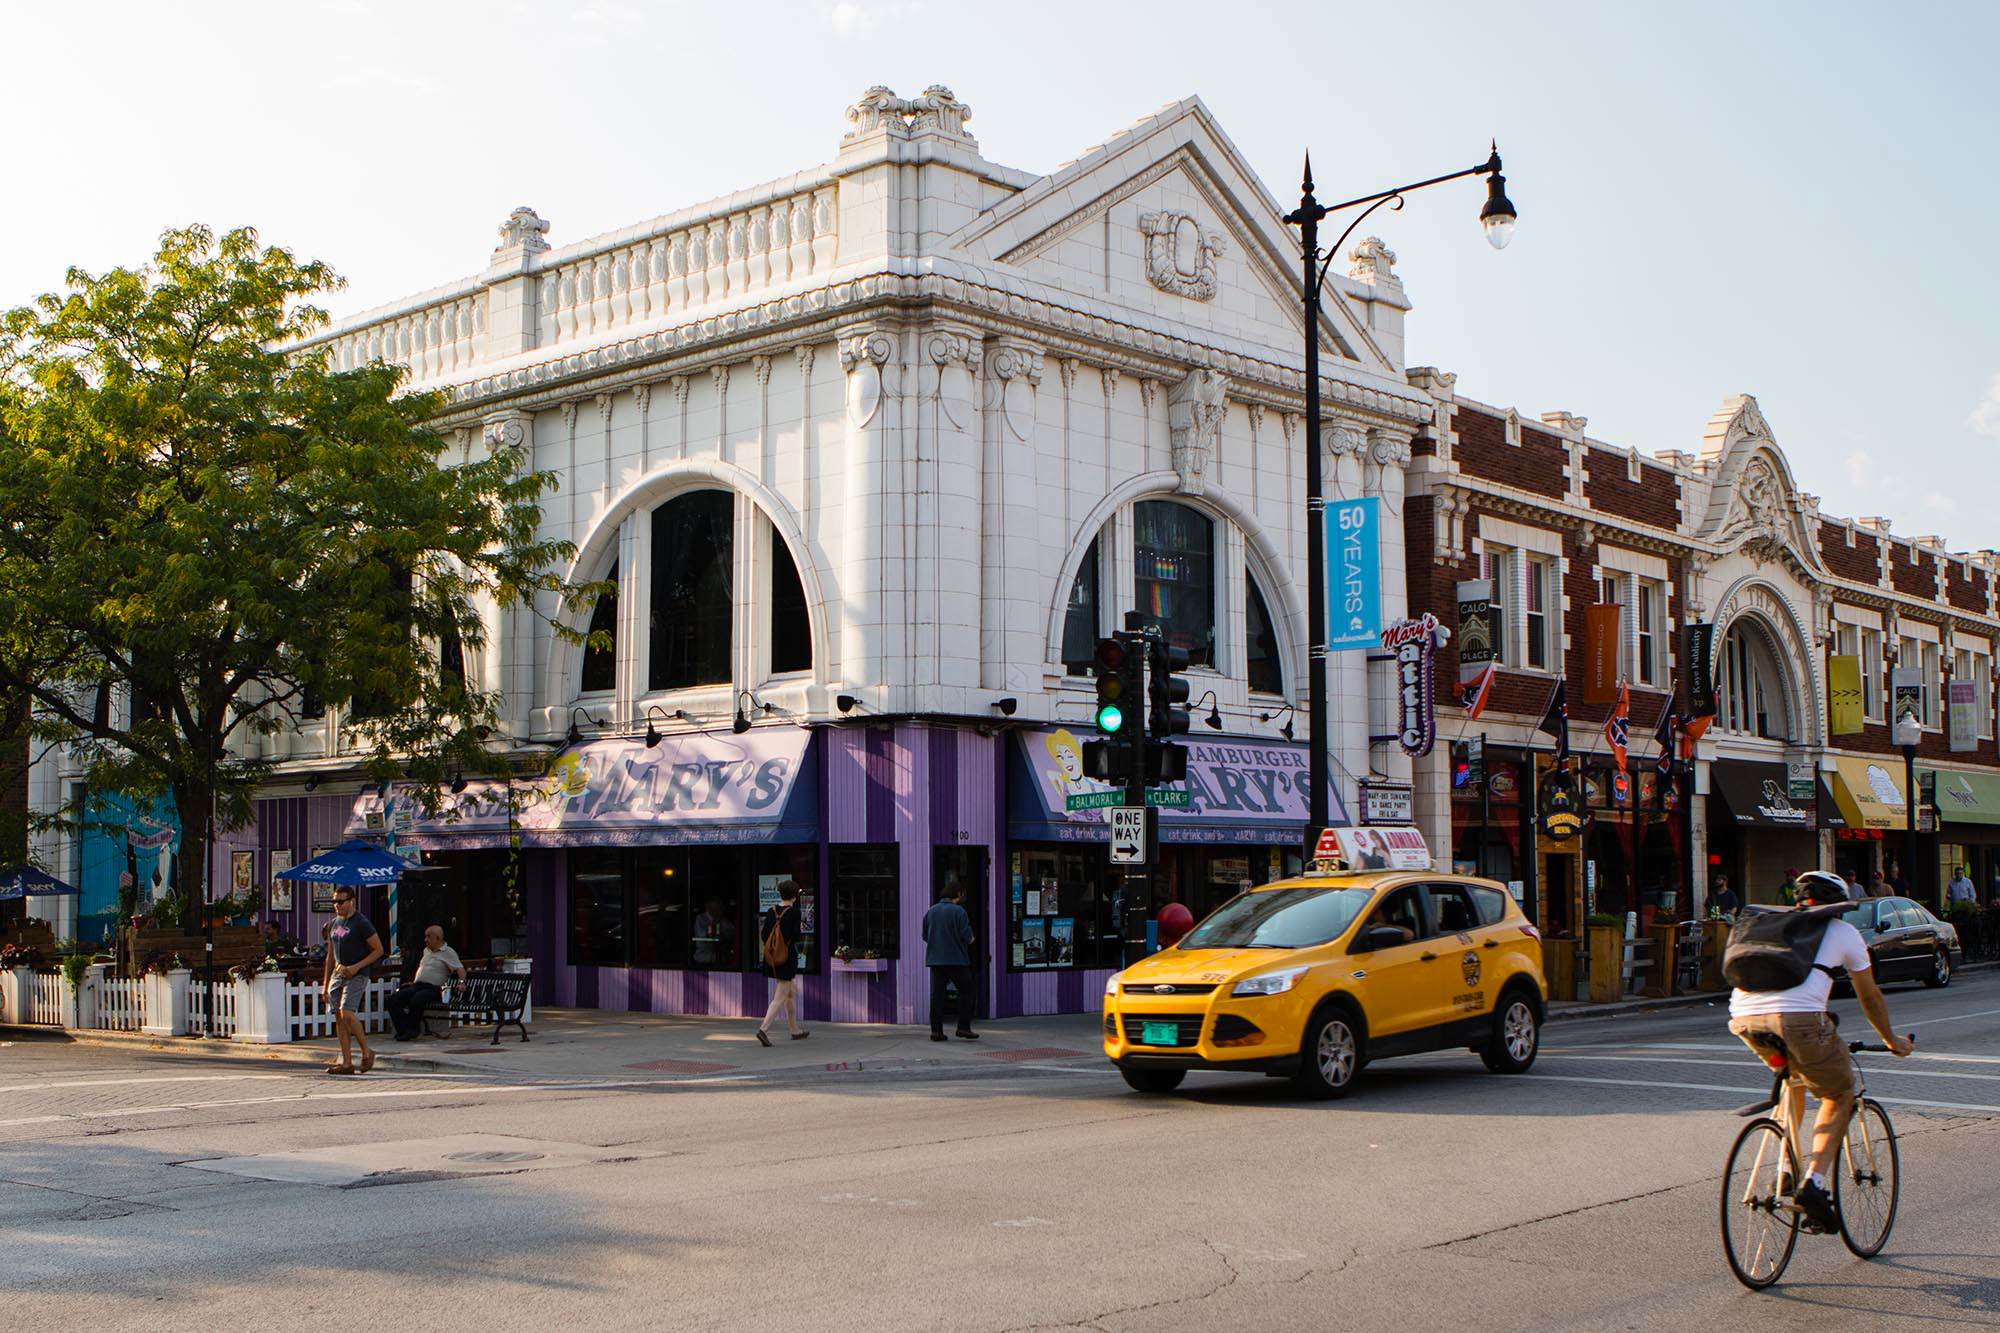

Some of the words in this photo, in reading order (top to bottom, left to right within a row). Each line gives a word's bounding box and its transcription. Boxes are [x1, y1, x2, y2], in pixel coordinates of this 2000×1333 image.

[1339, 506, 1365, 530] 50
[1344, 529, 1363, 613] YEARS
[1460, 602, 1487, 614] CALO
[1381, 615, 1435, 649] Mary's
[1462, 650, 1489, 661] PLACE
[1691, 629, 1703, 669] Publicity
[1399, 643, 1421, 747] attic
[1897, 687, 1918, 695] CALO
[566, 747, 790, 819] MARY'S
[1075, 795, 1115, 808] BALMORAL
[1153, 792, 1181, 804] CLARK
[1115, 812, 1141, 825] ONE
[1115, 828, 1141, 840] WAY
[306, 863, 344, 875] SKYY
[357, 865, 394, 877] SKYY
